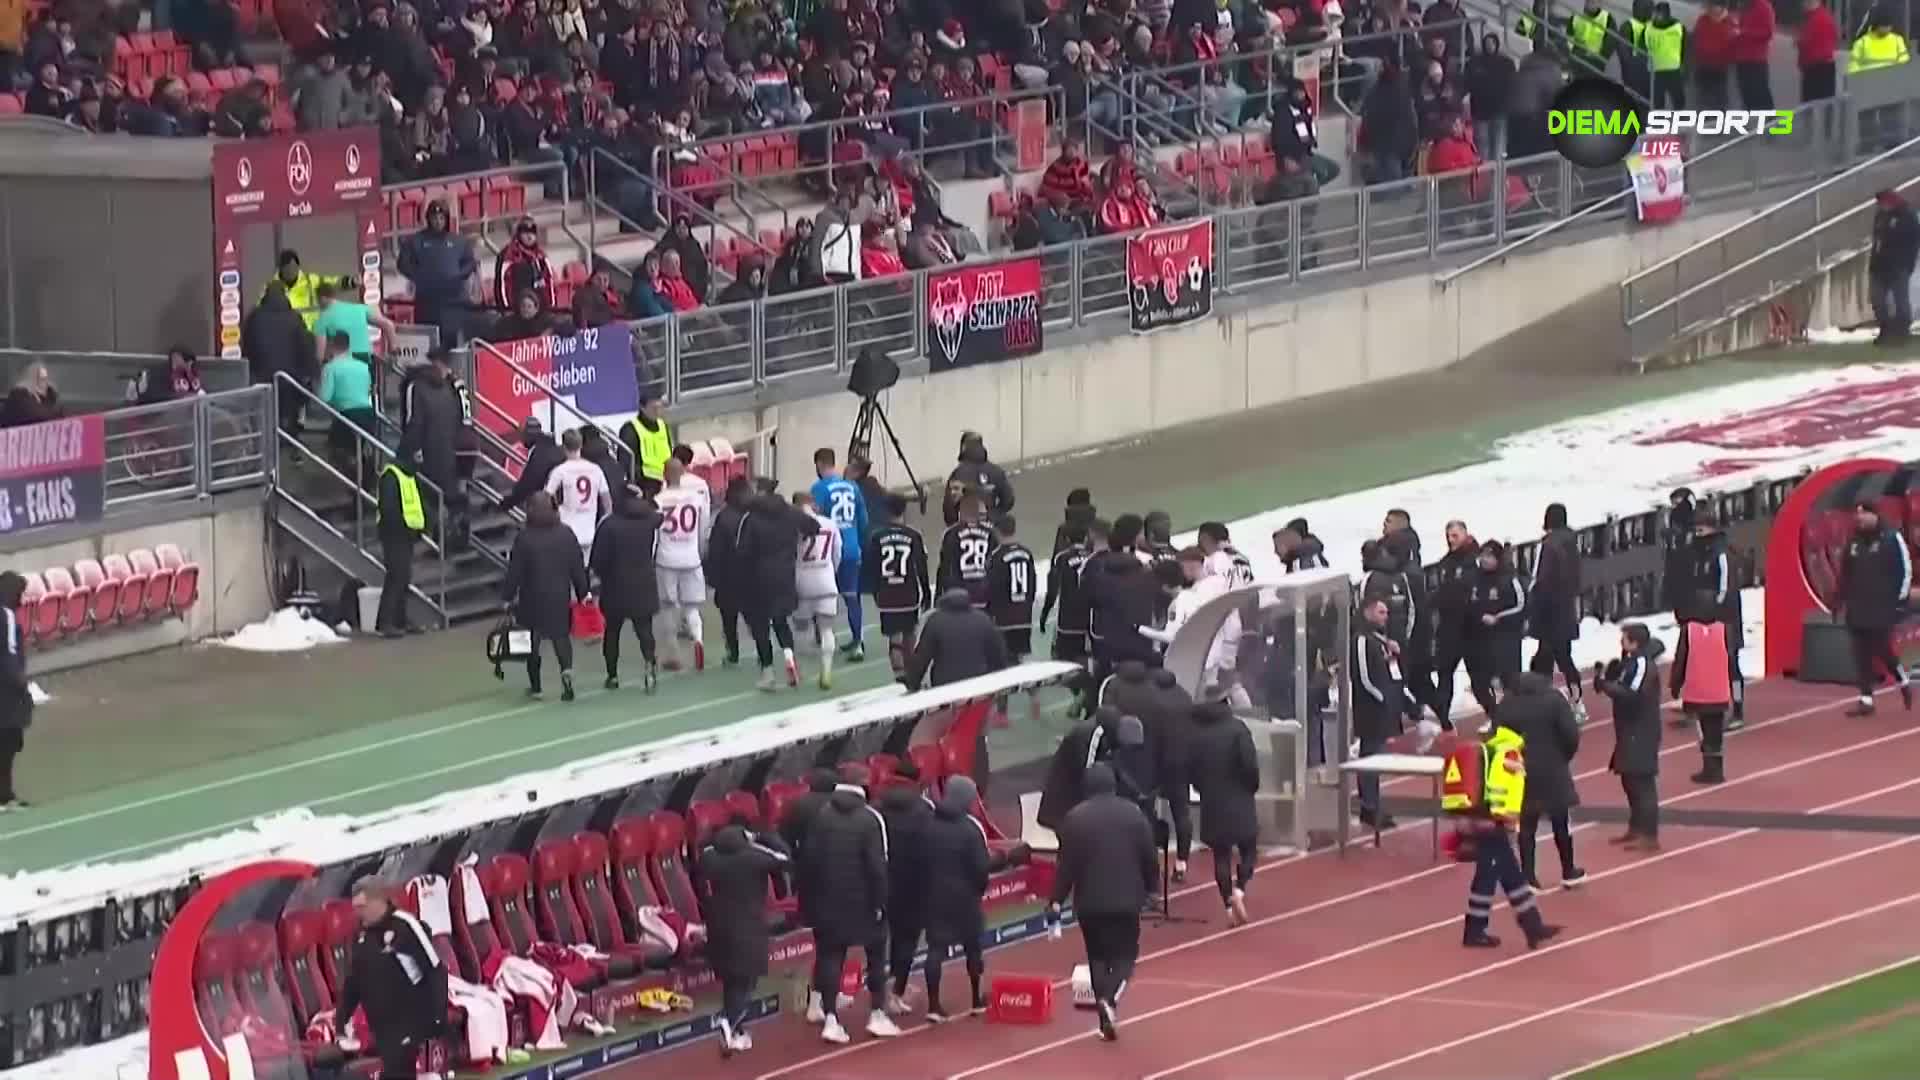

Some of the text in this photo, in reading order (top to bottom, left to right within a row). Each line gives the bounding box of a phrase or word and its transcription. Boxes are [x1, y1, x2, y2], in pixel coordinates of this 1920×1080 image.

[25, 476, 76, 526] FANS
[576, 475, 592, 504] 9
[662, 504, 698, 535] 30
[830, 491, 856, 522] 26
[801, 530, 833, 562] 27
[880, 544, 912, 577] 27
[959, 538, 989, 572] 28
[1009, 561, 1029, 594] 14
